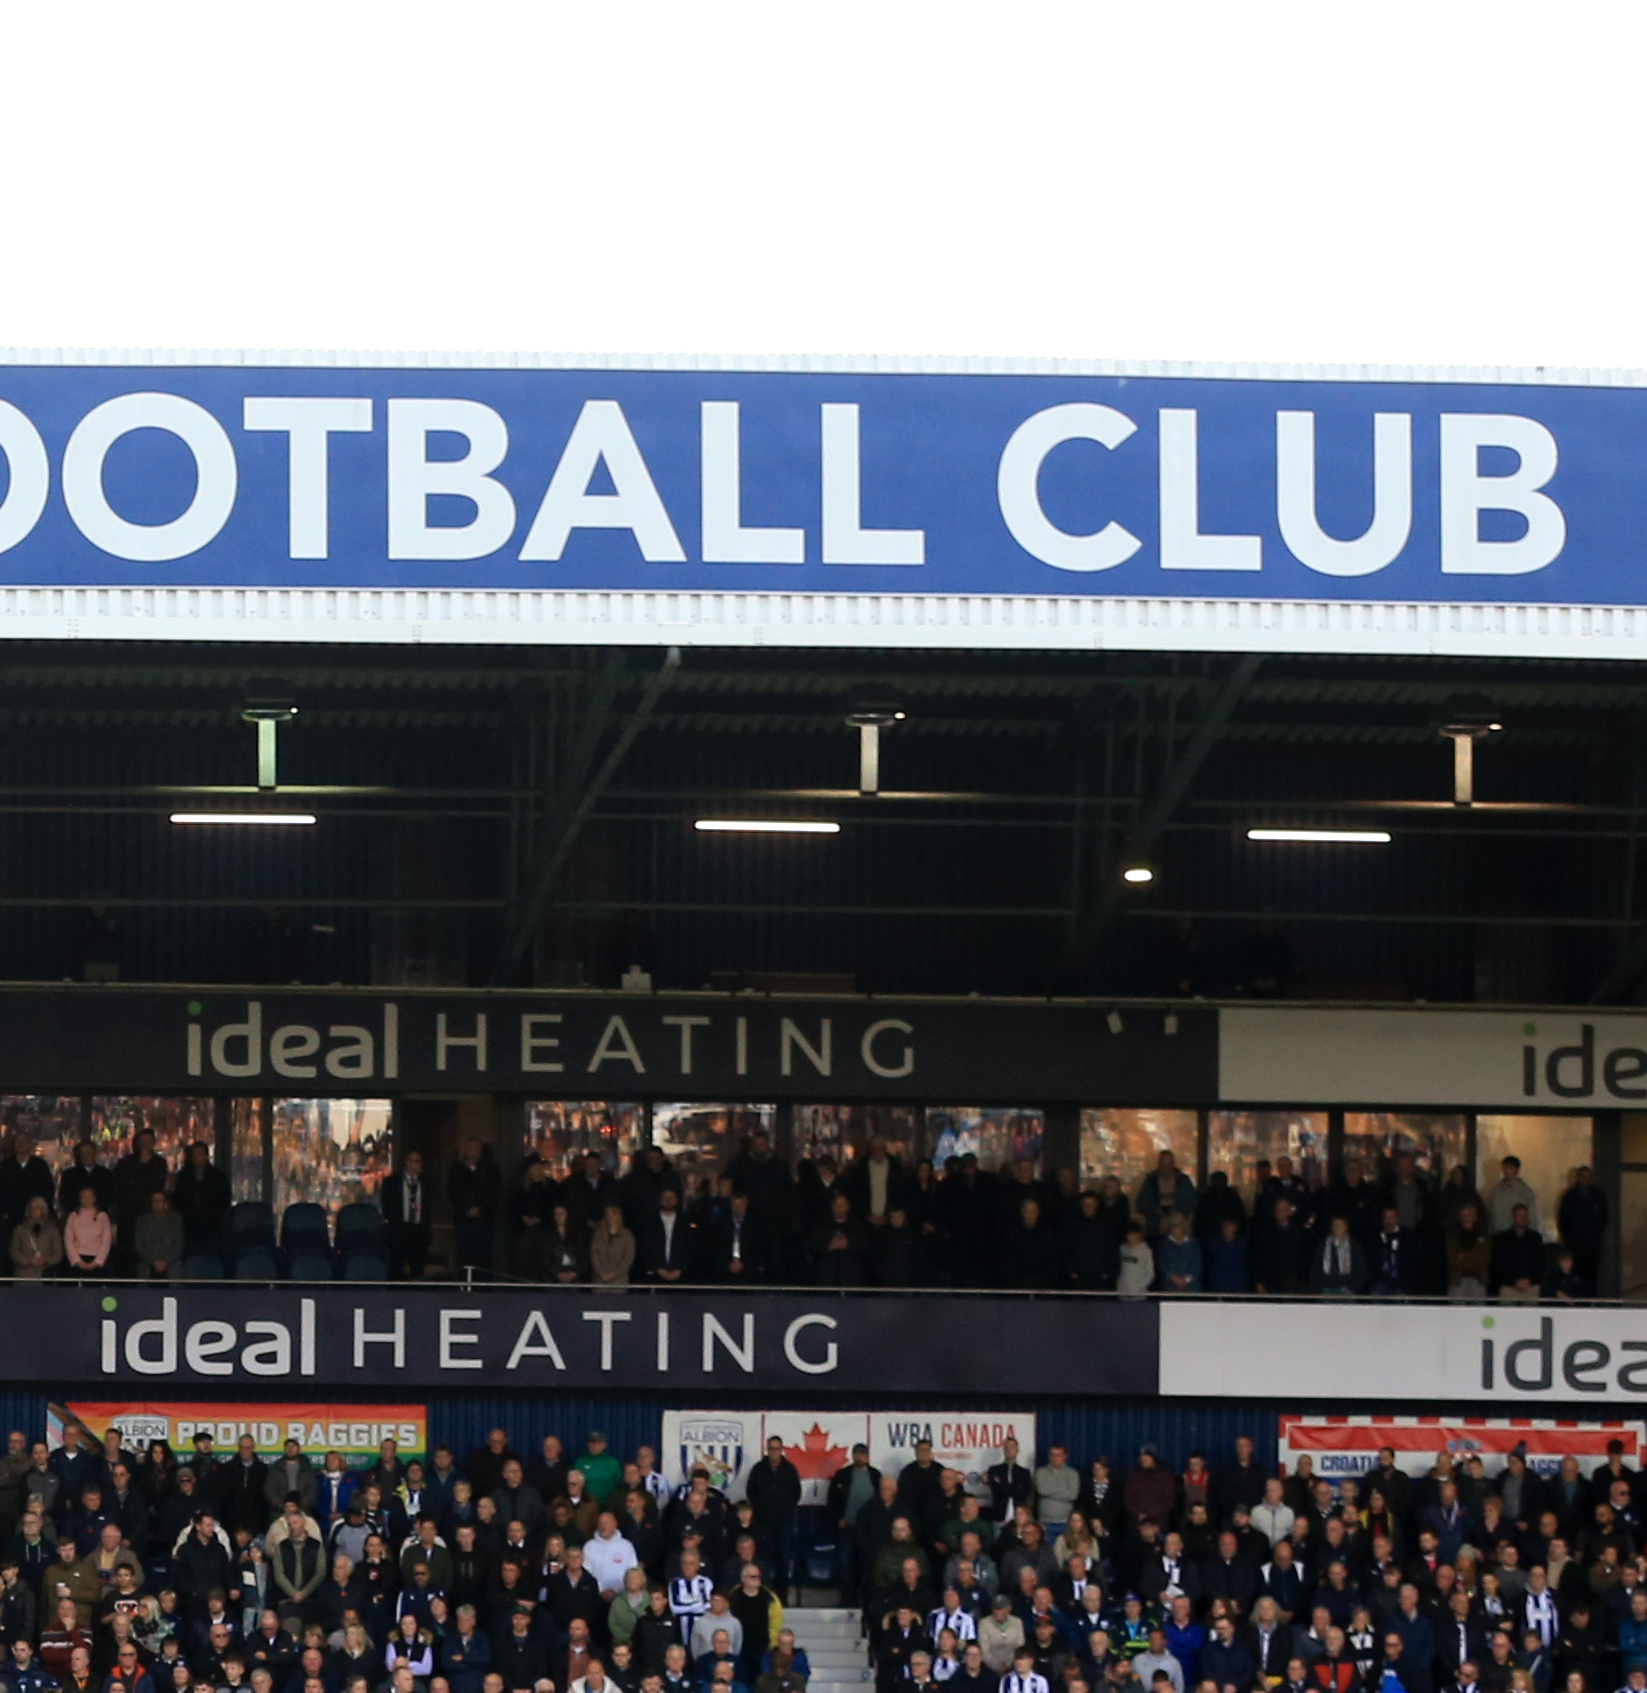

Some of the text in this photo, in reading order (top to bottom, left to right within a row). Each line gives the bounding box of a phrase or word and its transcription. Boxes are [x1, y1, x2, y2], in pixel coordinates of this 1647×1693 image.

[998, 403, 1565, 576] CLUB
[188, 1001, 913, 1078] ideal HEATING
[1523, 1022, 1647, 1099] ide
[102, 1297, 837, 1375] ideal HEATING
[1481, 1315, 1647, 1392] idea
[176, 1421, 417, 1447] PROUD BAGGIES
[682, 1430, 738, 1443] ALBION
